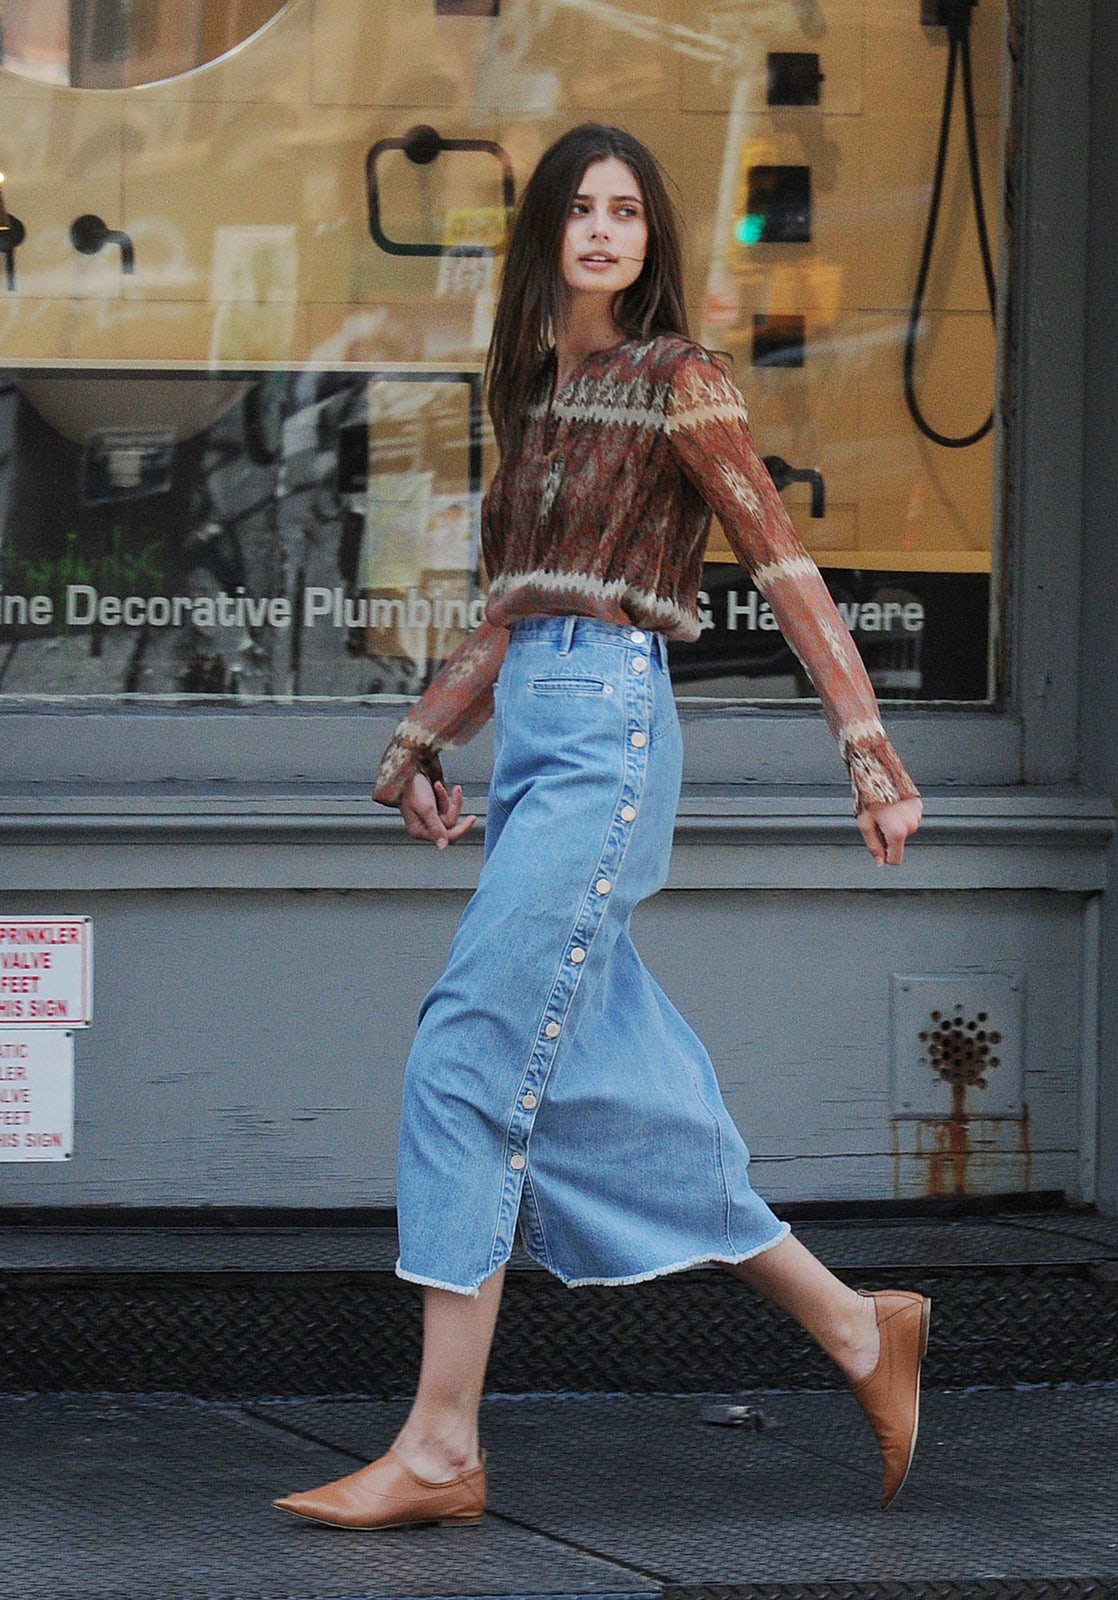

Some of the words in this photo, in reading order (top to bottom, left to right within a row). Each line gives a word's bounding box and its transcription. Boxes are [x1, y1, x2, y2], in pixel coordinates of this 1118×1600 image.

[66, 584, 292, 627] Decorative
[697, 590, 716, 630] &
[1, 952, 51, 969] VALVE
[0, 976, 39, 993] FEET
[30, 1000, 68, 1017] SIGN
[24, 1133, 62, 1147] SIGN
